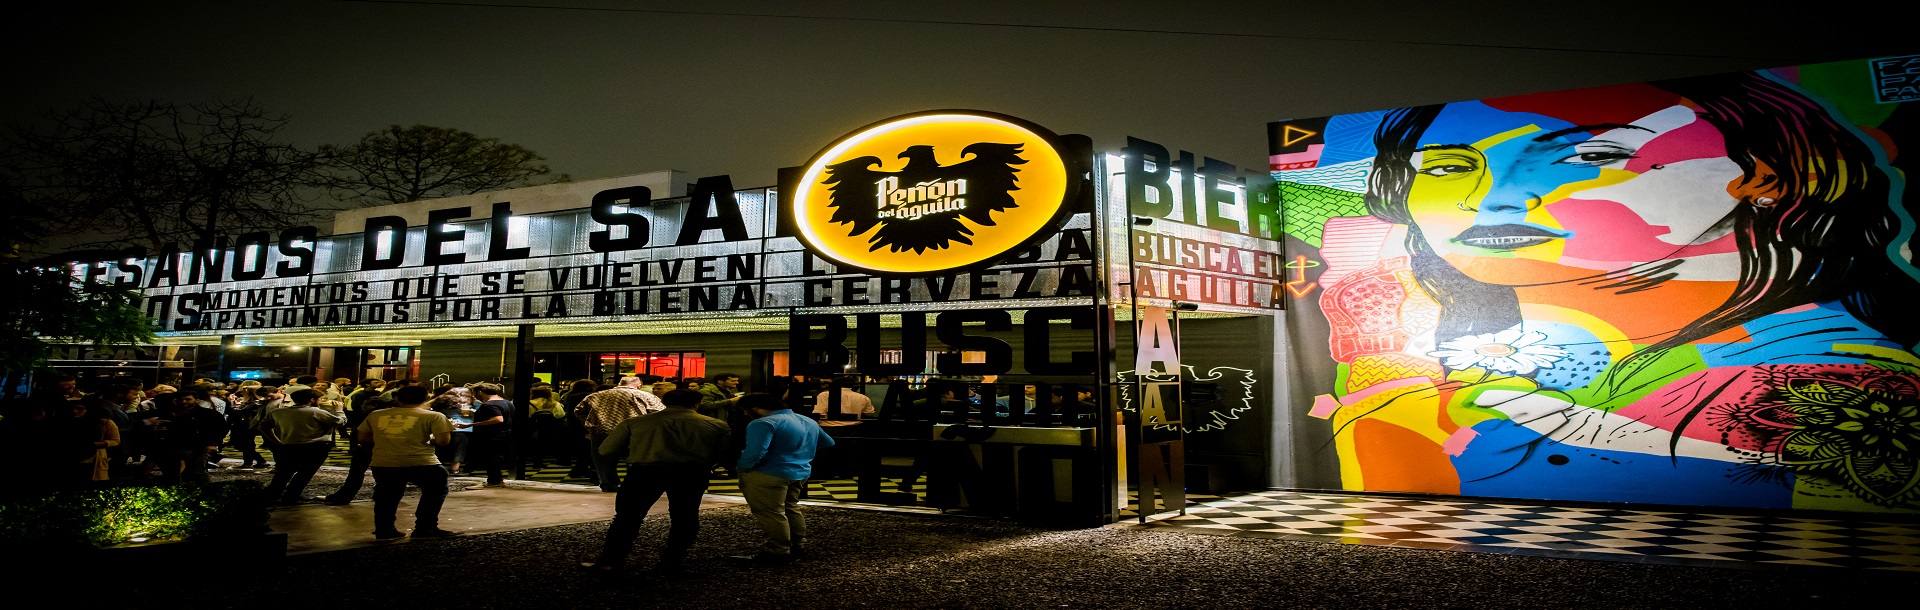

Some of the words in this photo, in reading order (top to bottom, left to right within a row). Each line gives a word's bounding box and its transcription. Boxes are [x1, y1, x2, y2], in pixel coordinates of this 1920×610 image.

[1127, 135, 1282, 240] BIER
[361, 202, 531, 271] DEL
[1132, 229, 1244, 276] BUSCA
[1253, 249, 1284, 281] EL
[199, 300, 411, 331] APASIONADOS
[428, 297, 503, 324] POR
[522, 292, 568, 319] LA
[593, 282, 761, 316] BUENA
[803, 260, 1093, 307] CERVEZA
[202, 280, 368, 312] MOMENTOS
[391, 273, 459, 302] QUE
[480, 270, 527, 296] SE
[549, 253, 756, 292] VUELVEN
[1136, 265, 1285, 309] AGUILA
